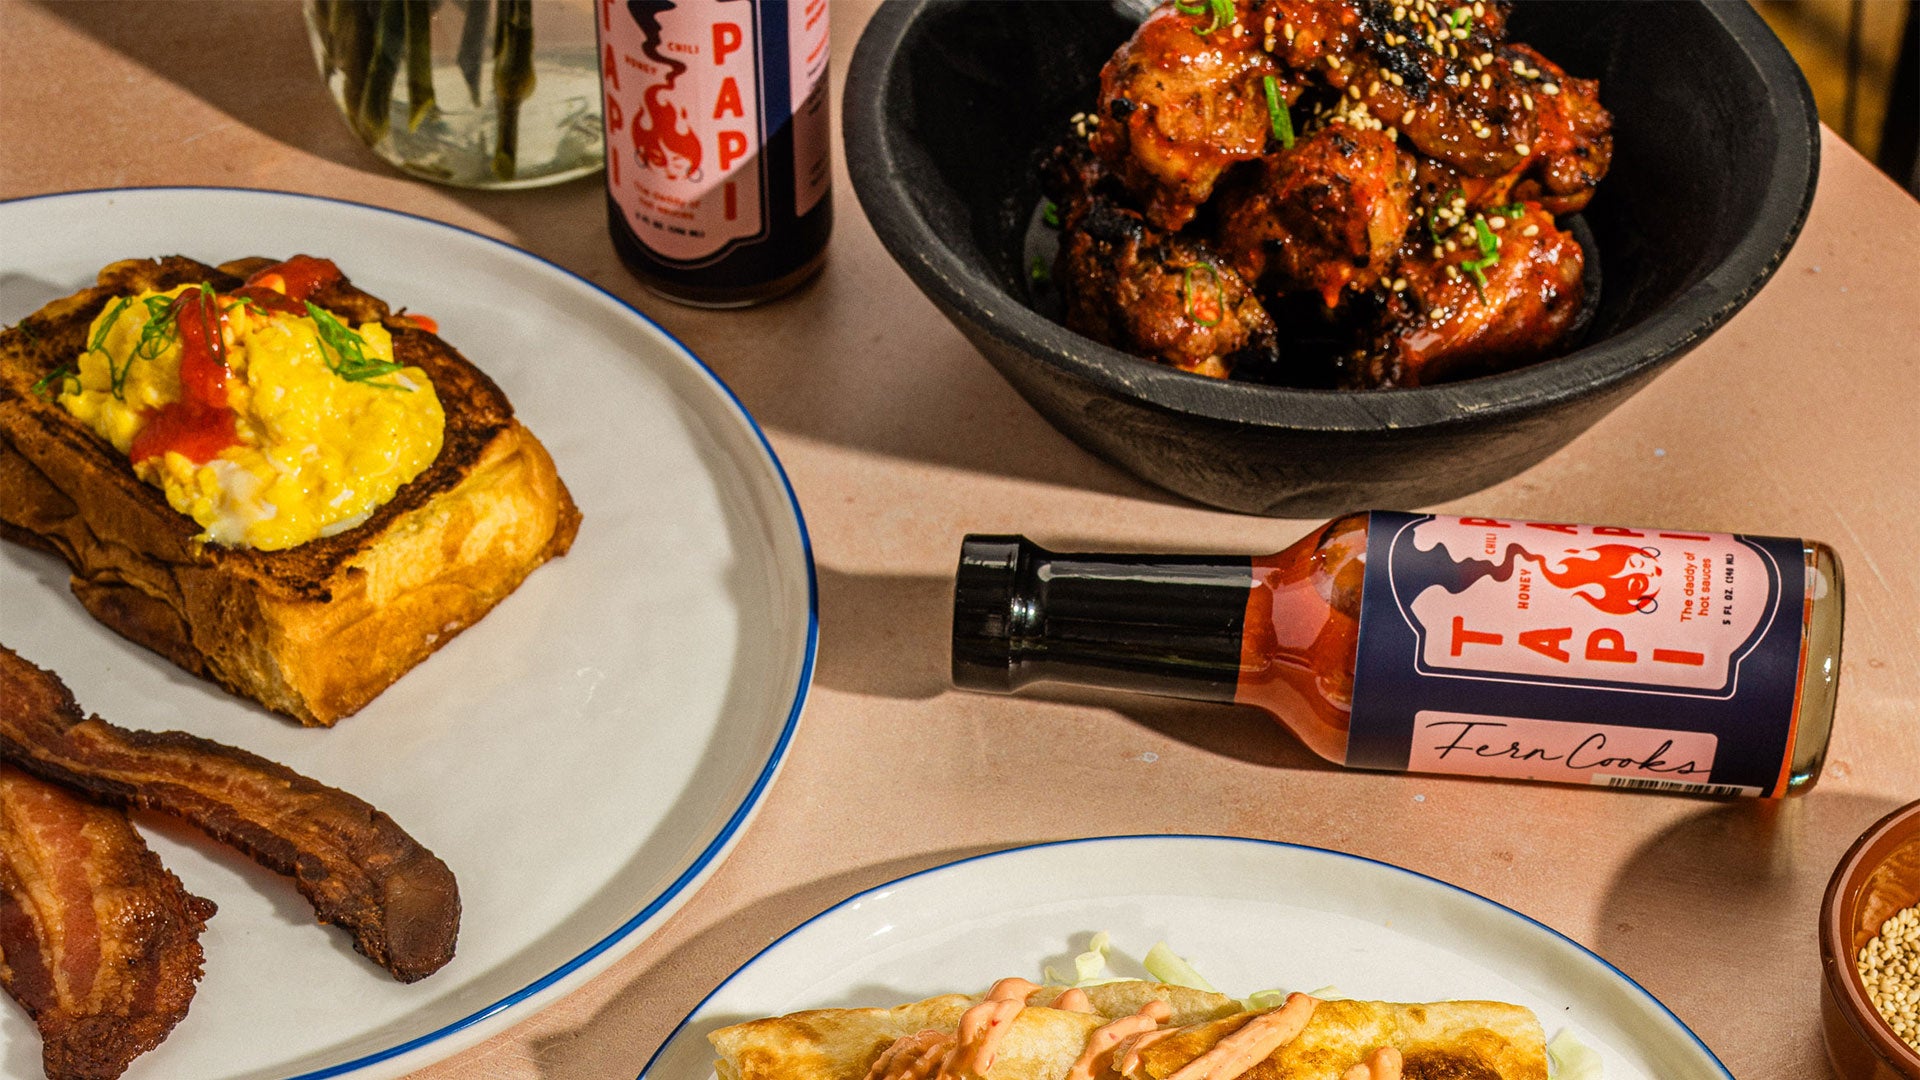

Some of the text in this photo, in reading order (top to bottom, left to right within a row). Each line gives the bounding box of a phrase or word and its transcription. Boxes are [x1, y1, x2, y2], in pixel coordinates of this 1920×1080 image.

[712, 22, 749, 221] PAPI
[1485, 532, 1497, 555] CHILI
[1516, 568, 1532, 610] HONEY
[1680, 552, 1698, 622] The daddy of
[1697, 558, 1712, 616] hot sauces
[1723, 605, 1733, 615] FL
[1450, 615, 1705, 666] TAPI
[1424, 720, 1713, 775] Fern Cooks
